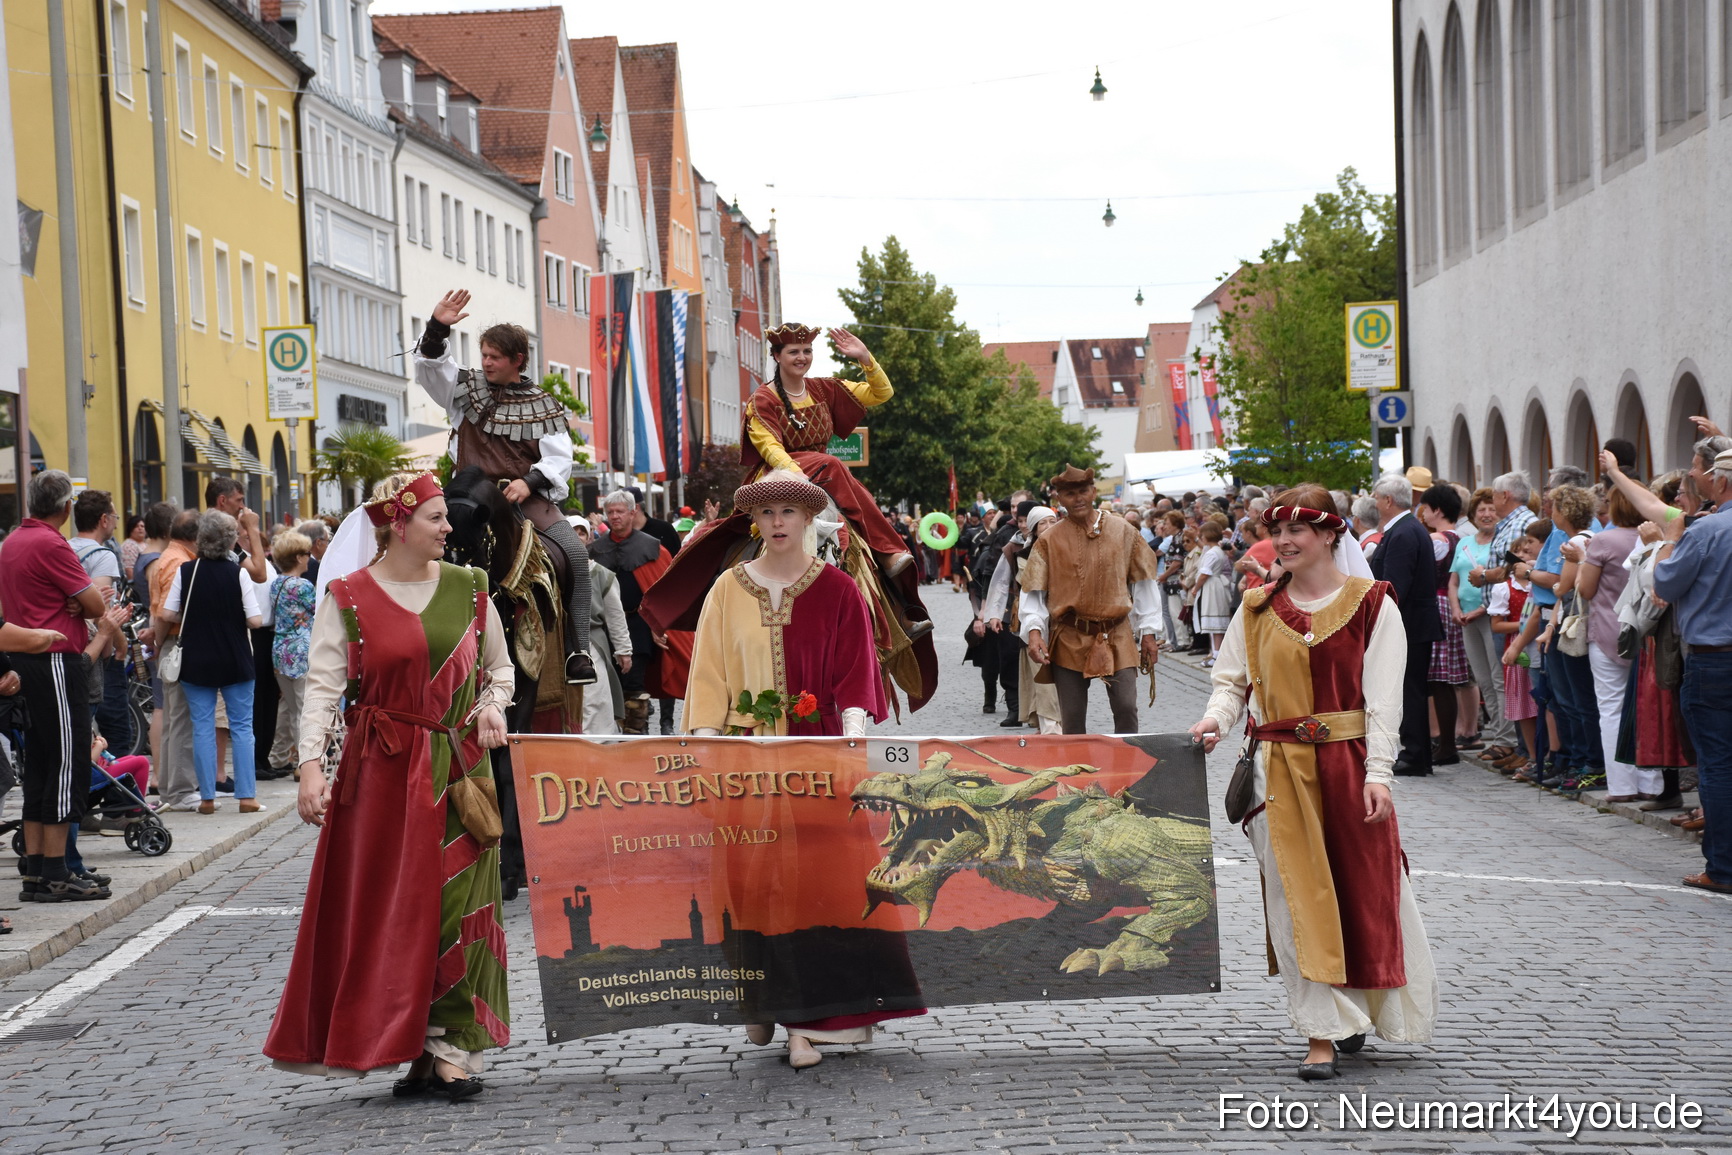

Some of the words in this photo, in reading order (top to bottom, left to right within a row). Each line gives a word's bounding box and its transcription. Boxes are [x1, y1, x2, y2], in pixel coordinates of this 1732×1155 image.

[1363, 318, 1381, 340] H
[280, 341, 297, 363] H
[826, 445, 859, 456] rghofspiele
[653, 753, 700, 774] DER
[885, 747, 910, 763] 63
[530, 771, 837, 824] DRACHENSTICH
[612, 834, 681, 855] FURTH
[689, 834, 715, 848] IM
[717, 825, 779, 846] WALD
[578, 966, 697, 992] Deutschlands
[701, 966, 766, 981] ältestes
[602, 986, 745, 1008] Volksschauspiel!
